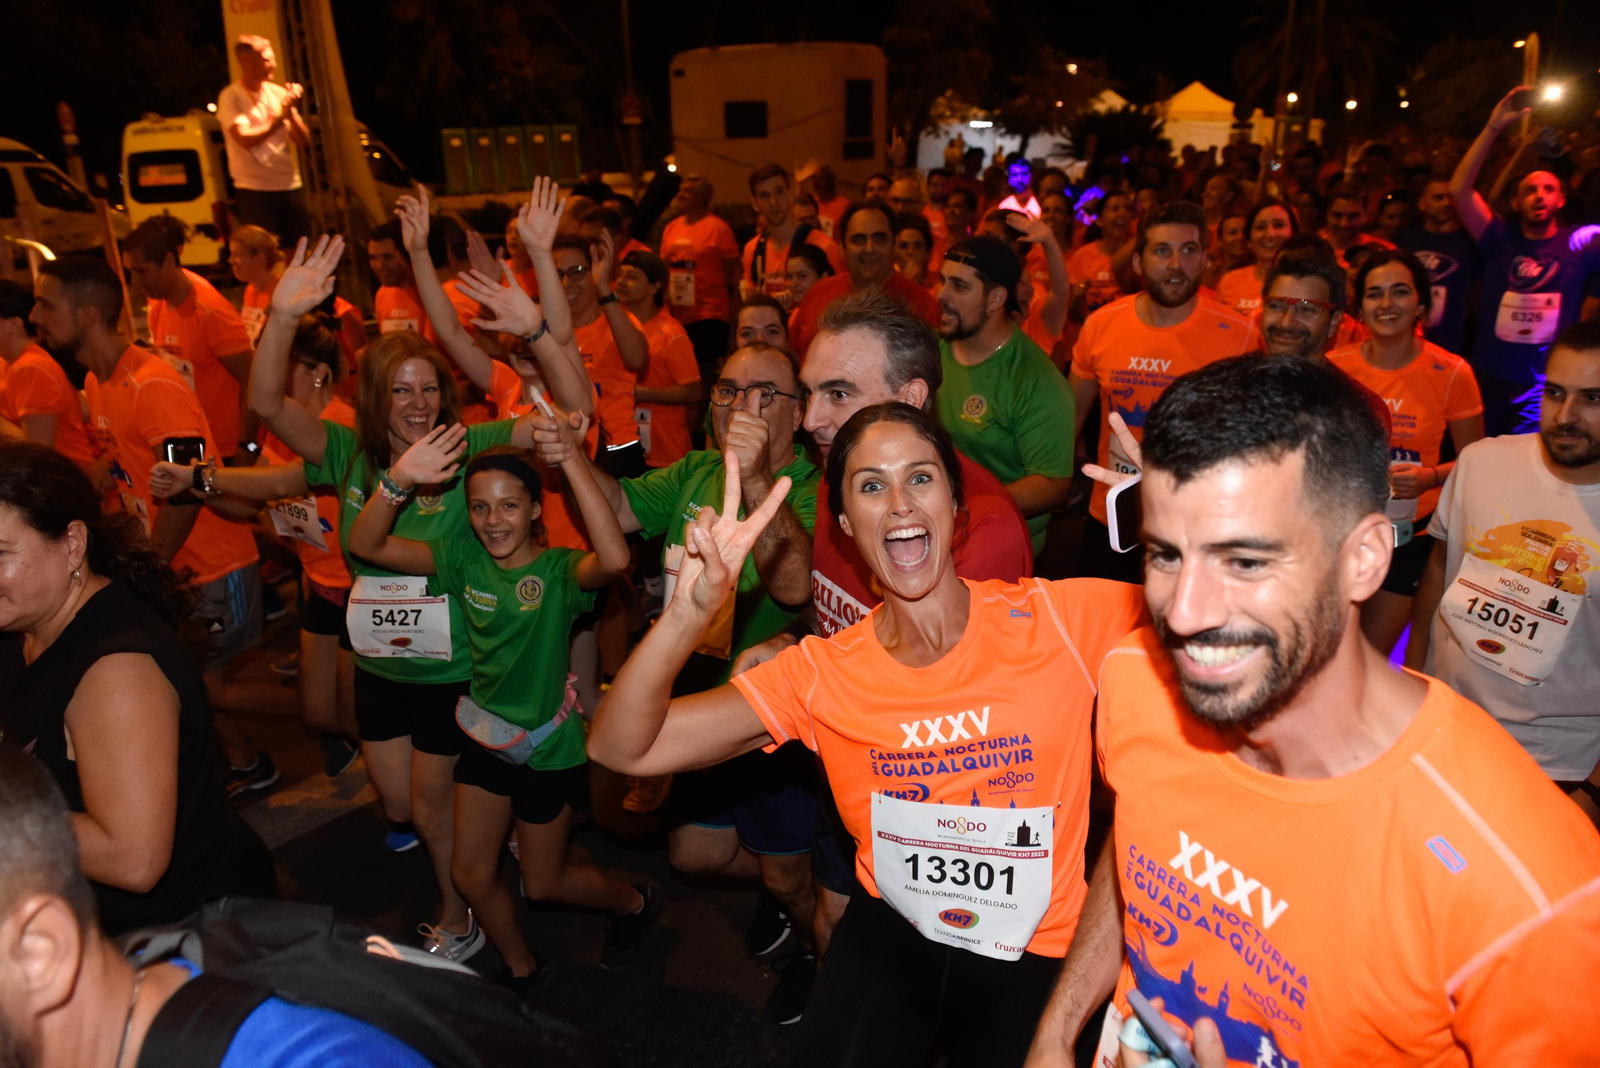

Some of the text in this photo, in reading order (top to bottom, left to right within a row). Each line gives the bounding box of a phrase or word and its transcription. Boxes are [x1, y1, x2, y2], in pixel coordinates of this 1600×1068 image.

[1511, 311, 1543, 323] 6326
[1128, 356, 1171, 373] XXXV
[372, 609, 422, 626] 5427
[1467, 597, 1540, 641] 15051
[899, 706, 990, 749] XXXV
[870, 733, 1032, 761] CARRERA NOCTURNA
[880, 748, 1034, 778] GUADALQUIVIR
[880, 833, 897, 841] XXXV
[897, 837, 925, 846] CARRERA
[925, 841, 959, 850] NOCTURNA
[971, 848, 1017, 858] GUADALQUIVIR
[904, 853, 1014, 896] 13301
[1168, 830, 1289, 930] XXXV
[904, 884, 1018, 911] AMELIA DOMINGUEZ DELGADO
[1129, 844, 1310, 992] CARRERA NOCTURNA
[1134, 871, 1306, 1011] GUADALQUIVIR
